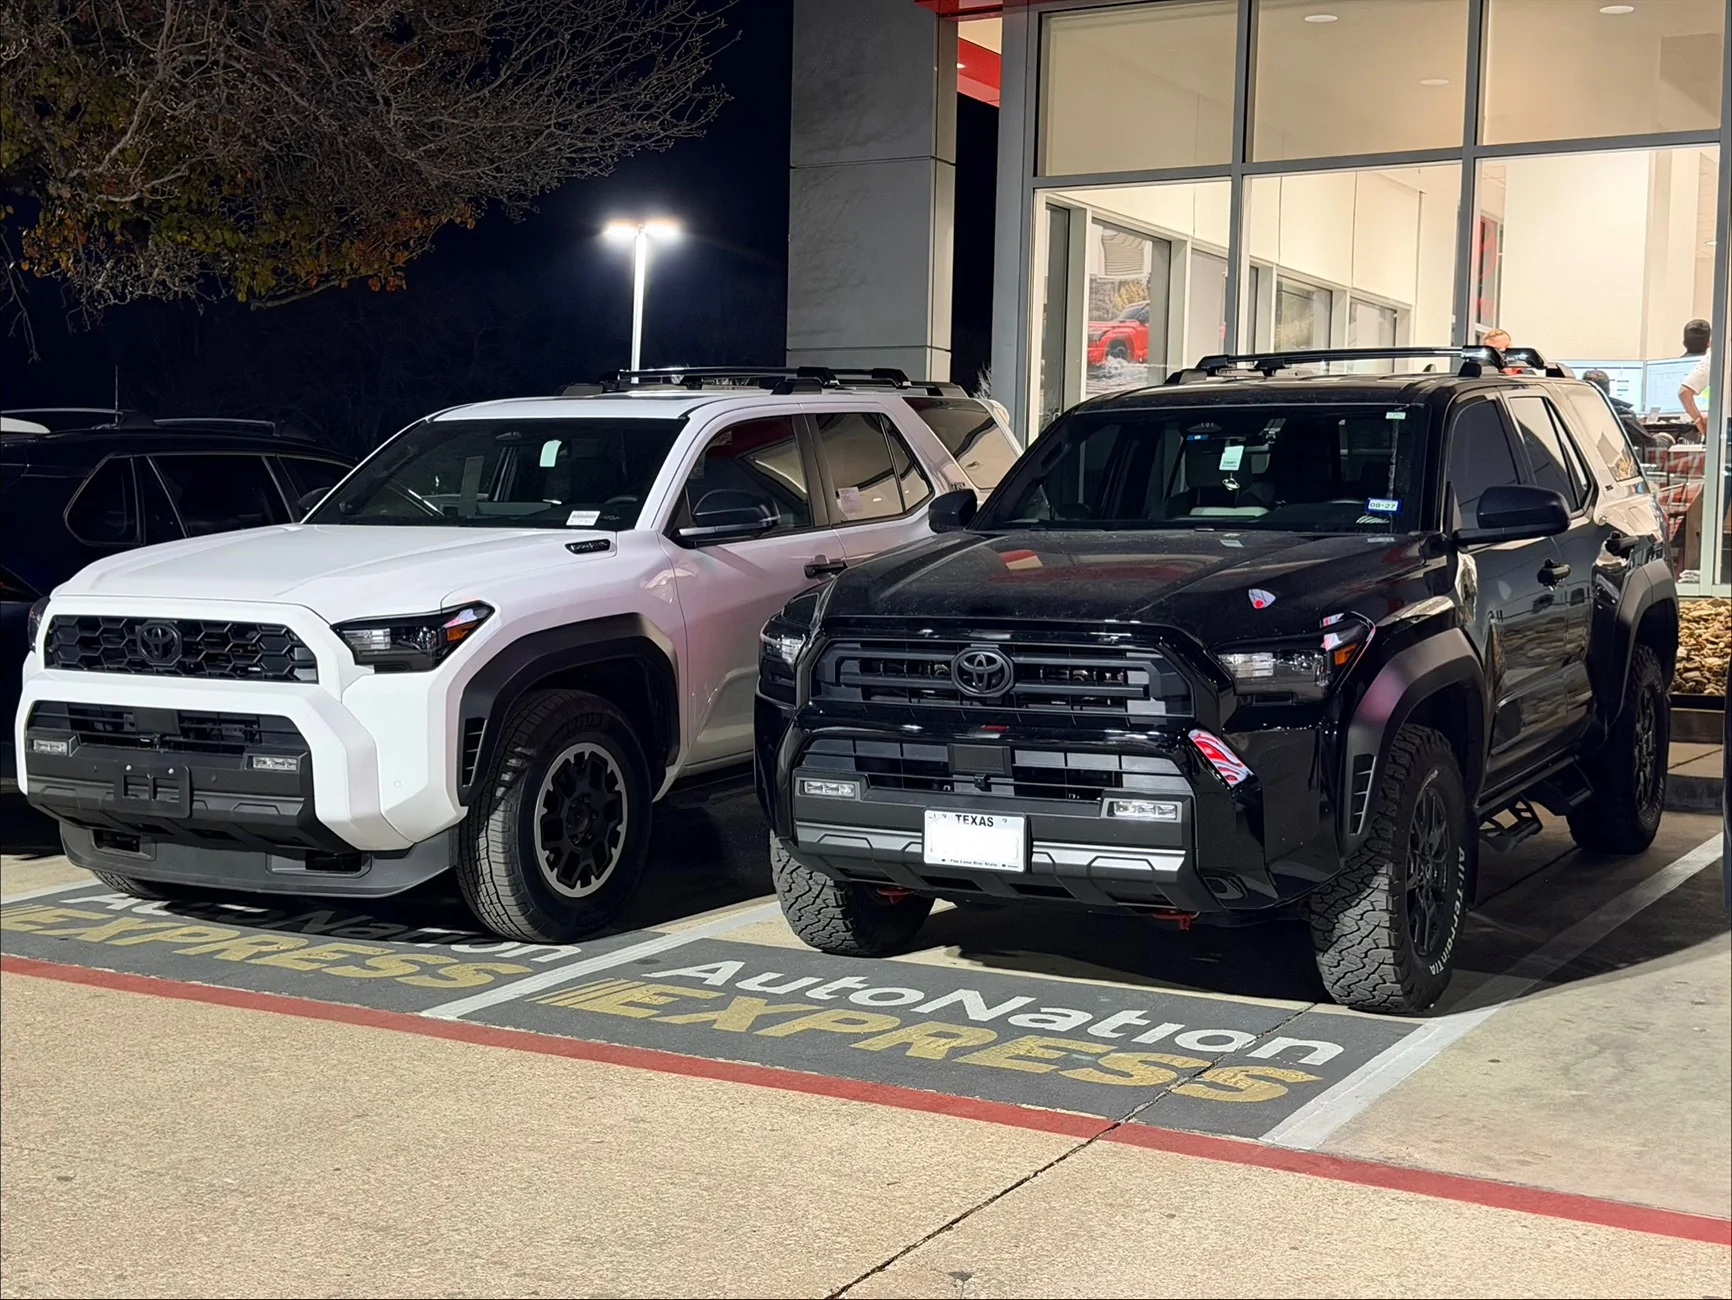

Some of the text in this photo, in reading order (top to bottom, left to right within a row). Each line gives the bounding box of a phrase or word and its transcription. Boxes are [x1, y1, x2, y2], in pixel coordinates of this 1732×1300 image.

[955, 813, 994, 827] TEXAS
[1, 906, 534, 988] EXPRESS
[1441, 846, 1466, 963] All-Terrain
[566, 983, 1323, 1103] EXPRESS
[641, 960, 1345, 1066] AutoNation
